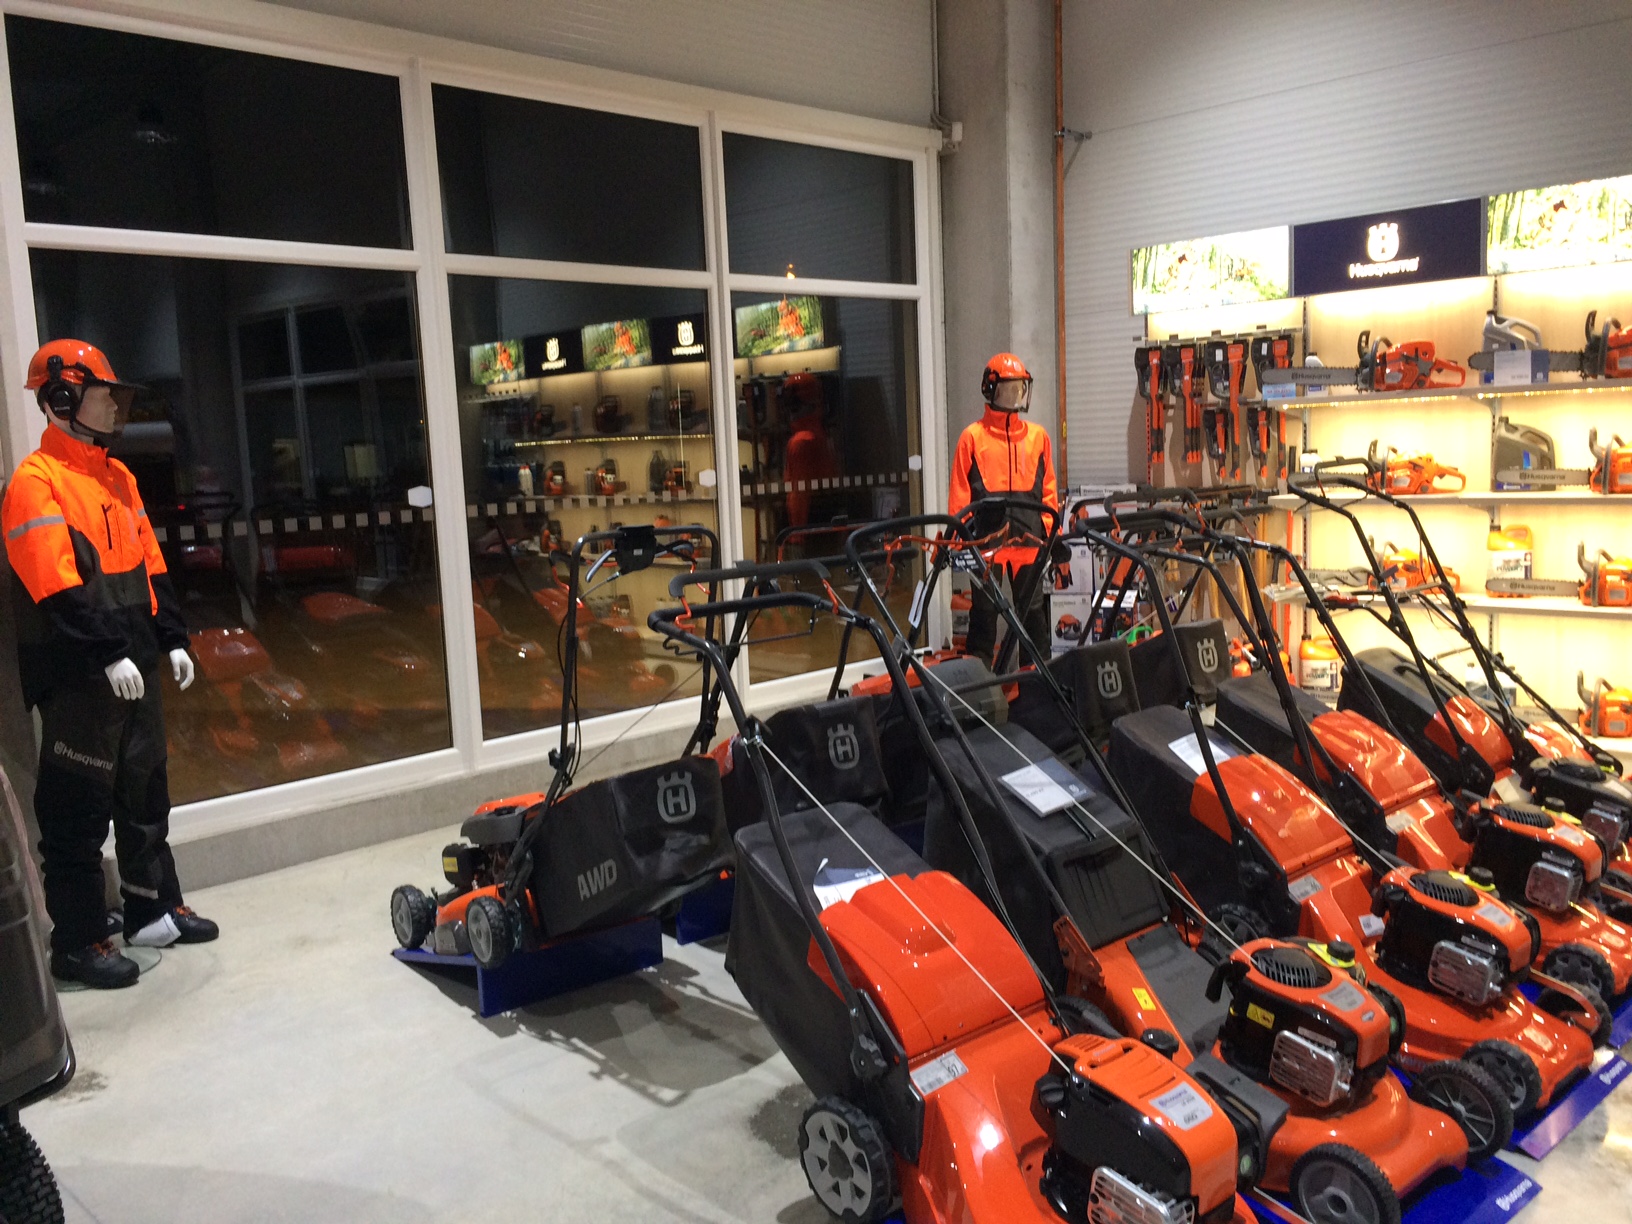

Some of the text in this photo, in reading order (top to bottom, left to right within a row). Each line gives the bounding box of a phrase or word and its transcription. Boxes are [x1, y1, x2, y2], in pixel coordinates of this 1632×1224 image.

[1349, 257, 1420, 278] Husqvarna
[1527, 472, 1566, 481] Husqvarna
[1517, 583, 1556, 591] Husqvarna
[62, 743, 114, 771] Husqvarna
[577, 857, 617, 901] AWD
